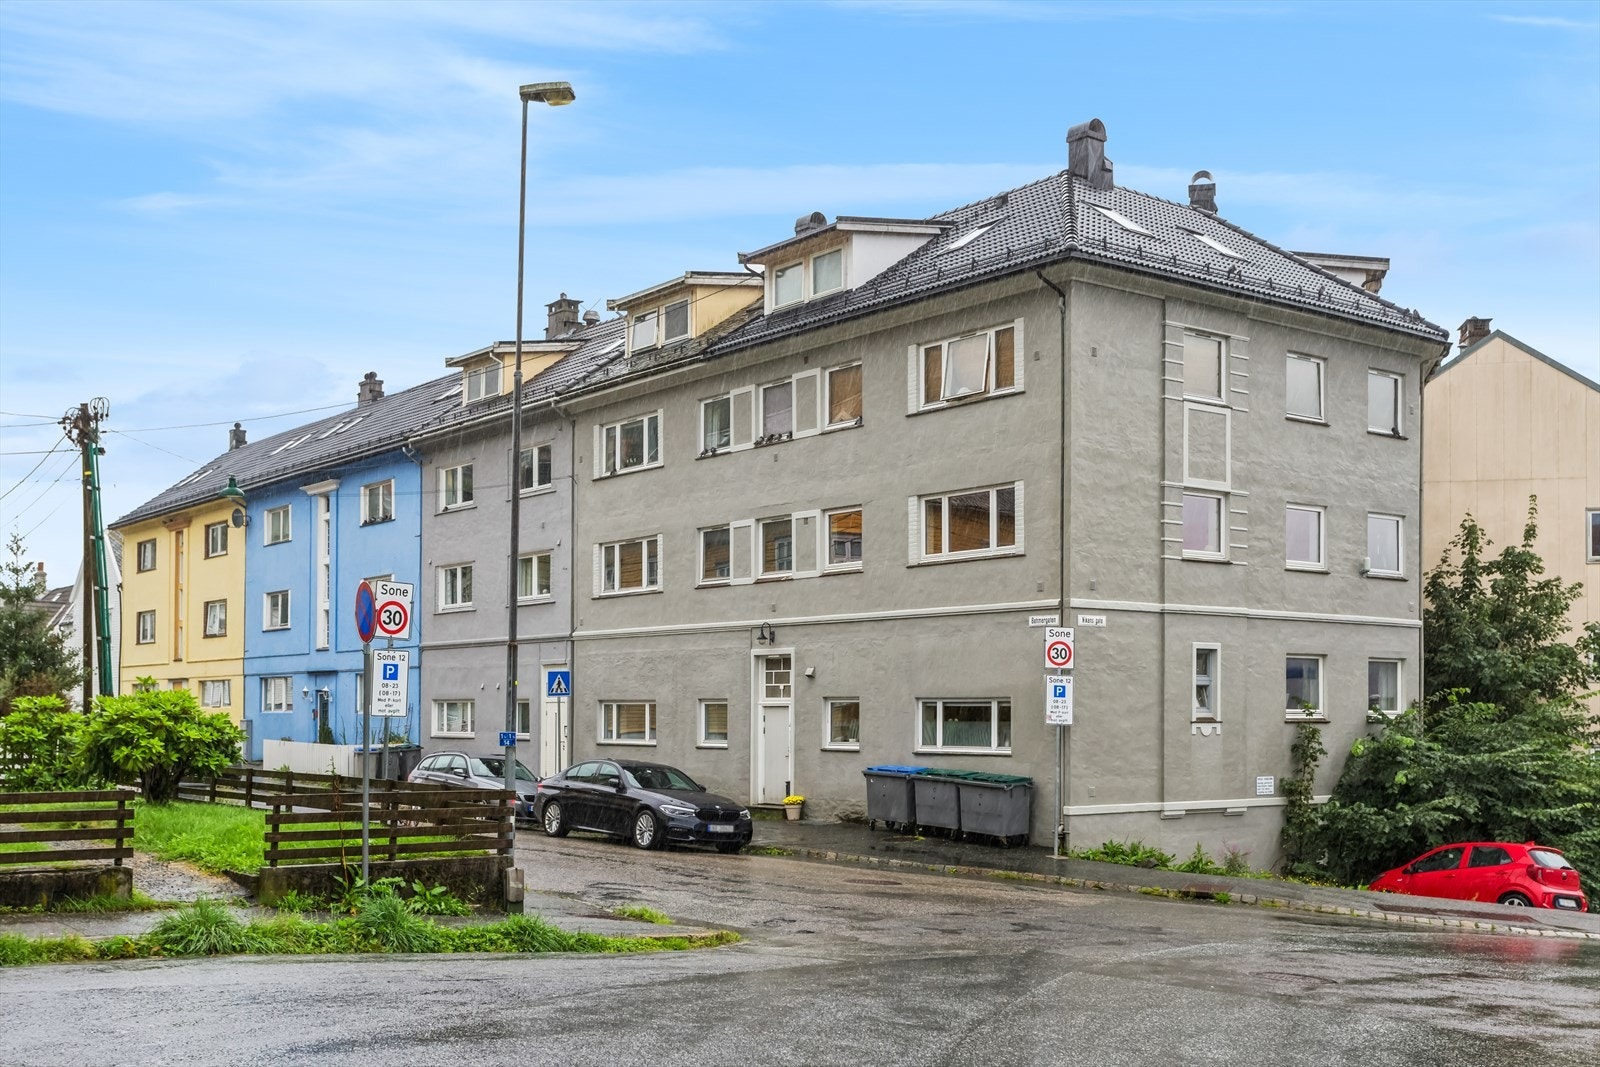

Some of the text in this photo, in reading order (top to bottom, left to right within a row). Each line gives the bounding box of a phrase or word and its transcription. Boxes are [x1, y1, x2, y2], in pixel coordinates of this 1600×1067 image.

[381, 584, 409, 598] Sone
[383, 609, 402, 626] 30
[1048, 628, 1071, 638] Sone
[377, 652, 406, 662] Sone 12
[1051, 647, 1068, 660] 30
[386, 665, 395, 679] P
[1048, 676, 1064, 684] Sone
[1056, 686, 1063, 697] P
